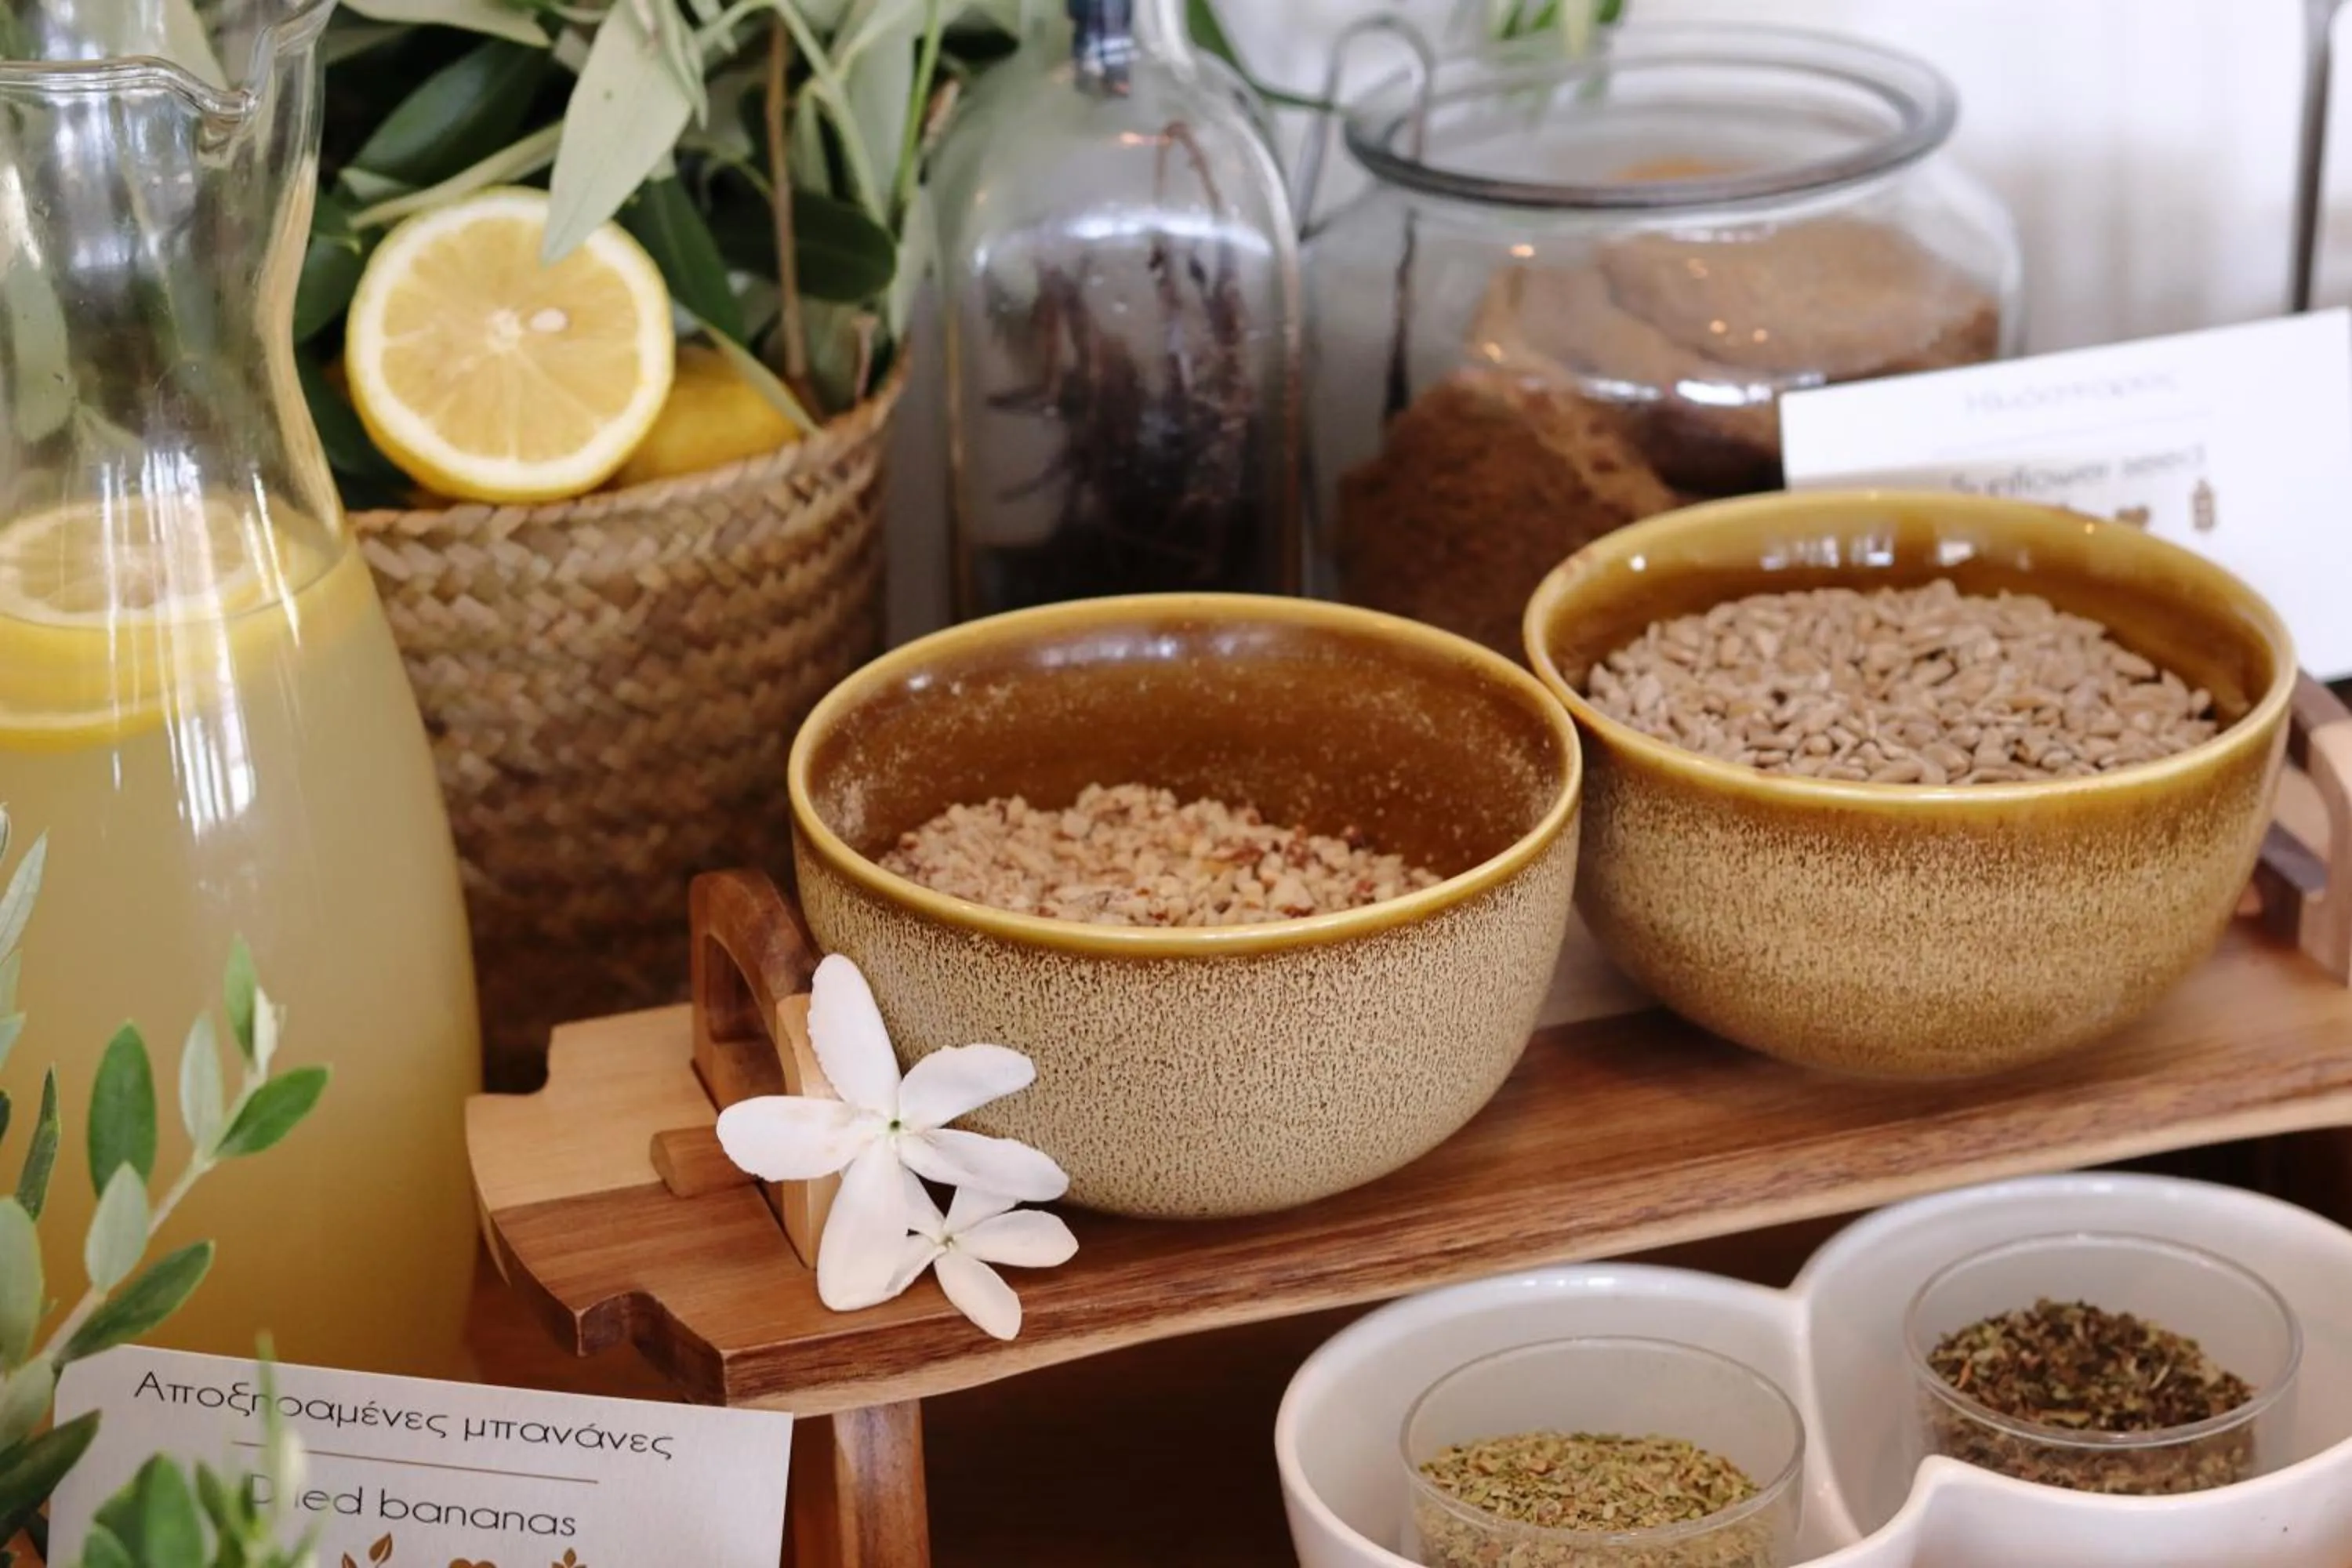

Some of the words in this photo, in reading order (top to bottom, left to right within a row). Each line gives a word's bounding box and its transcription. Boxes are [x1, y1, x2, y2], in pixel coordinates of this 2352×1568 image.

[464, 1417, 674, 1460] μπανάνες
[250, 1474, 363, 1515] Died
[379, 1488, 576, 1537] bananas
